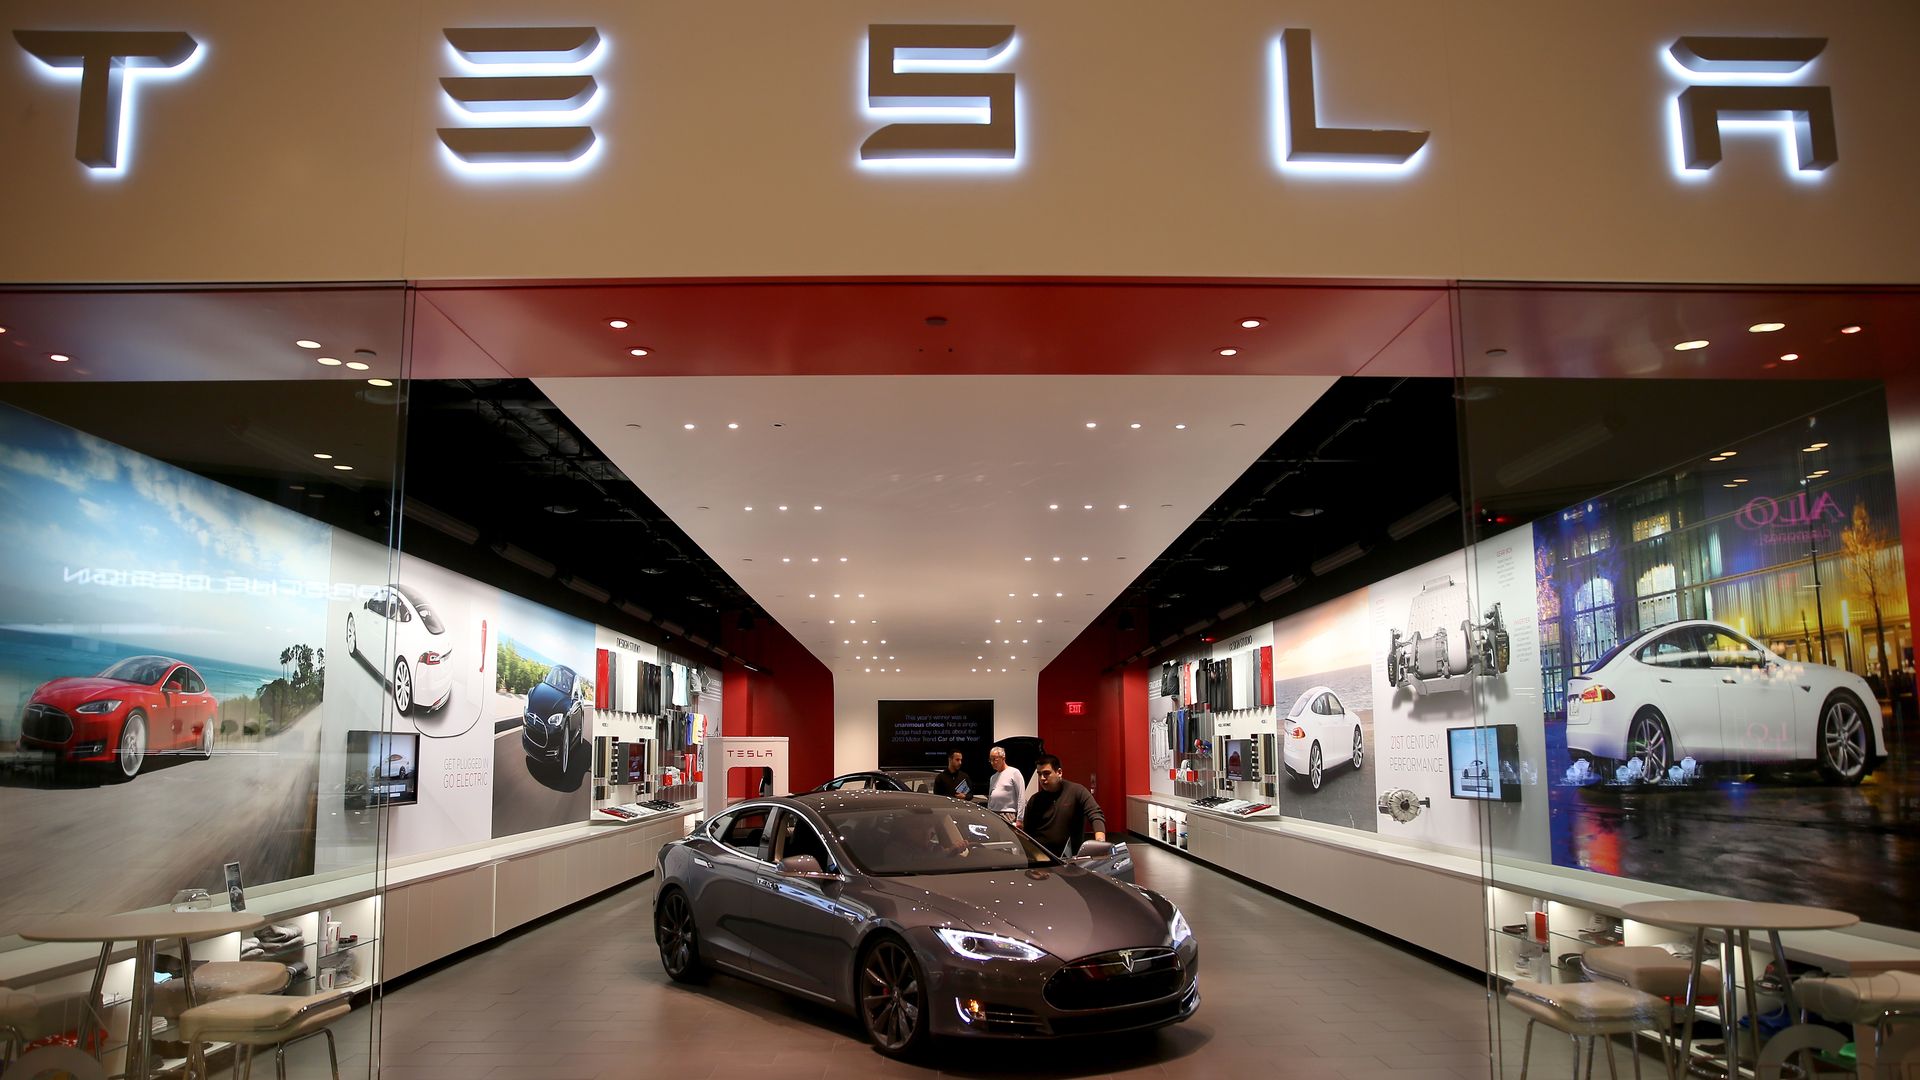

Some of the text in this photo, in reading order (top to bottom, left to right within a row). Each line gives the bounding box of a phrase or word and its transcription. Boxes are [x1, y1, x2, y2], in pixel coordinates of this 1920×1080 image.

[12, 24, 1838, 172] TESLA
[1068, 704, 1081, 714] EXIT
[1405, 734, 1440, 749] CENTURY
[726, 749, 773, 758] TESLA
[443, 758, 455, 770] GET
[1390, 757, 1444, 773] PERFORMANCE
[443, 771, 489, 789] GO ELECTRIC
